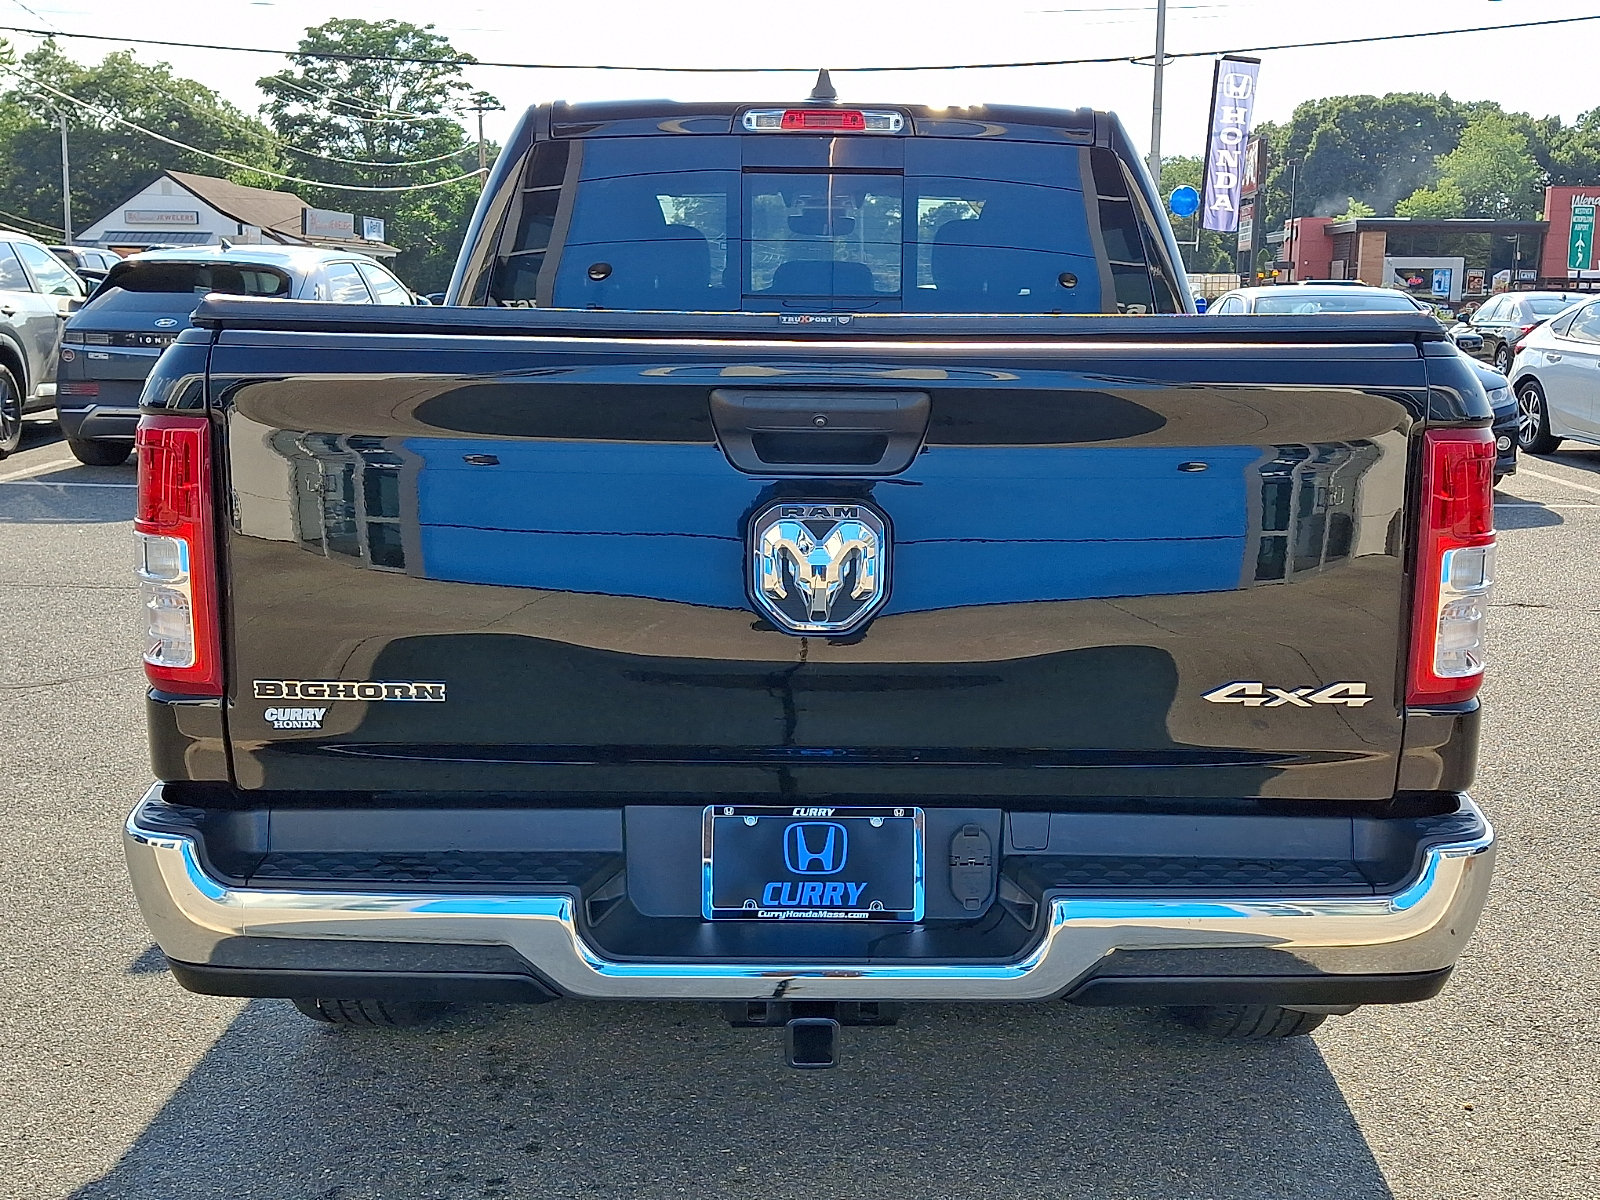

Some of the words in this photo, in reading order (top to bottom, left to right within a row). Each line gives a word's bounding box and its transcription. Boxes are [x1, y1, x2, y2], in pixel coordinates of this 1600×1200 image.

[1210, 106, 1248, 211] HONDA
[781, 507, 860, 518] RAM
[253, 680, 446, 702] BIGHORN
[1201, 681, 1374, 707] 4x4
[264, 707, 326, 721] CURRY
[273, 720, 321, 729] HONDA
[793, 807, 835, 817] CURRY
[762, 881, 867, 906] CURRY
[757, 910, 869, 920] CurryHondaMass.com
